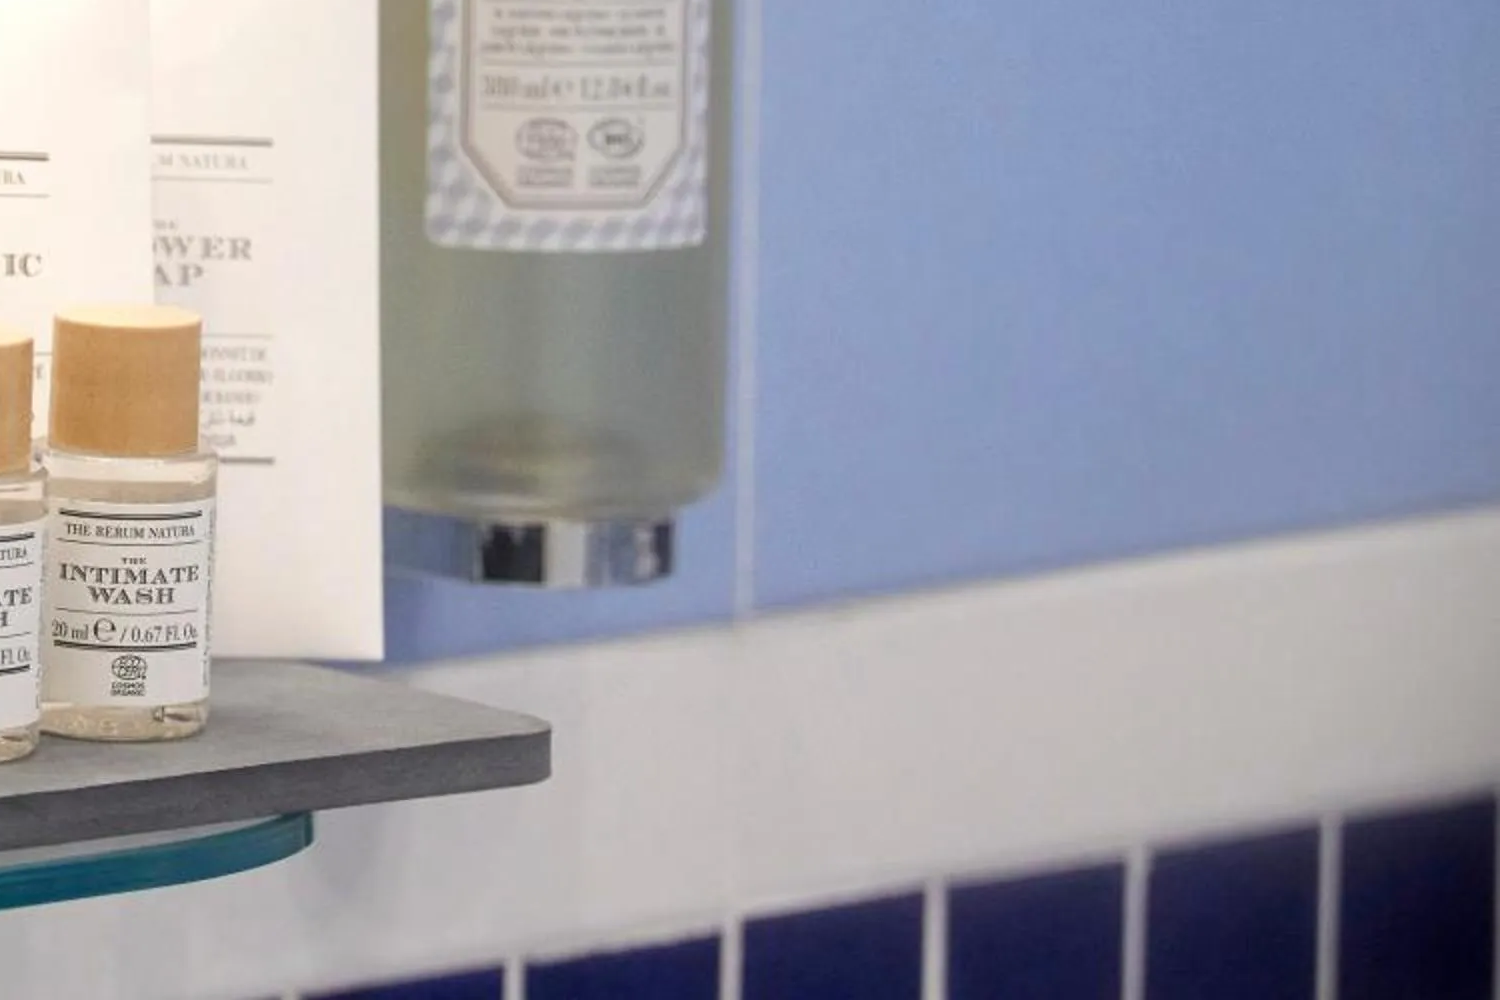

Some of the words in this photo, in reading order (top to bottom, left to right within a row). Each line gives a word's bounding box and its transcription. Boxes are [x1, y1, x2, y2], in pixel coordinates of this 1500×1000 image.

[152, 235, 253, 261] WER
[154, 263, 205, 286] AP
[64, 523, 91, 536] THE
[96, 525, 145, 539] RERUM
[148, 525, 195, 539] NATURA
[122, 556, 147, 565] THE
[59, 562, 199, 585] INTIMATE
[88, 586, 175, 605] WASH
[51, 619, 68, 637] 20
[72, 623, 89, 640] ml
[131, 625, 162, 642] 0.67
